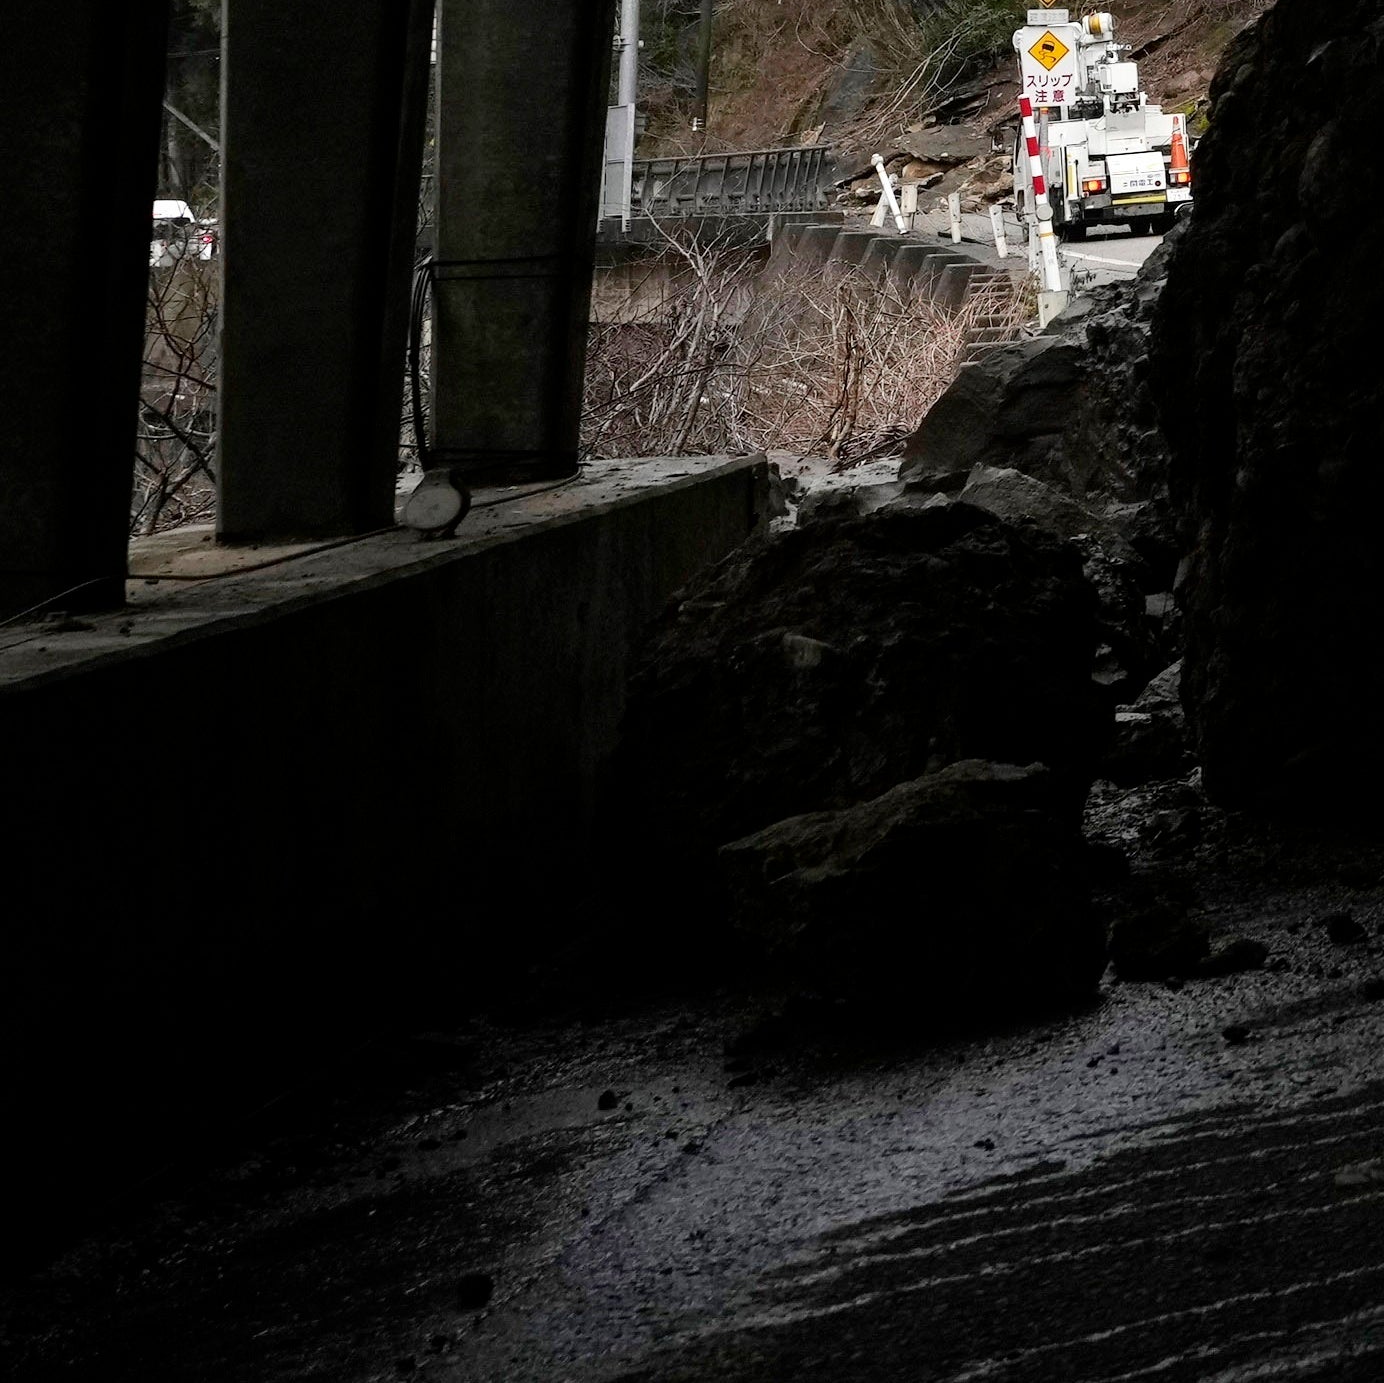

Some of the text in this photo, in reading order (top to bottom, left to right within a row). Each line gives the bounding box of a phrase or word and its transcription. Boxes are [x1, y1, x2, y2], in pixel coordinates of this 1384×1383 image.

[1027, 74, 1073, 88] スリップ
[1035, 89, 1065, 103] 注意
